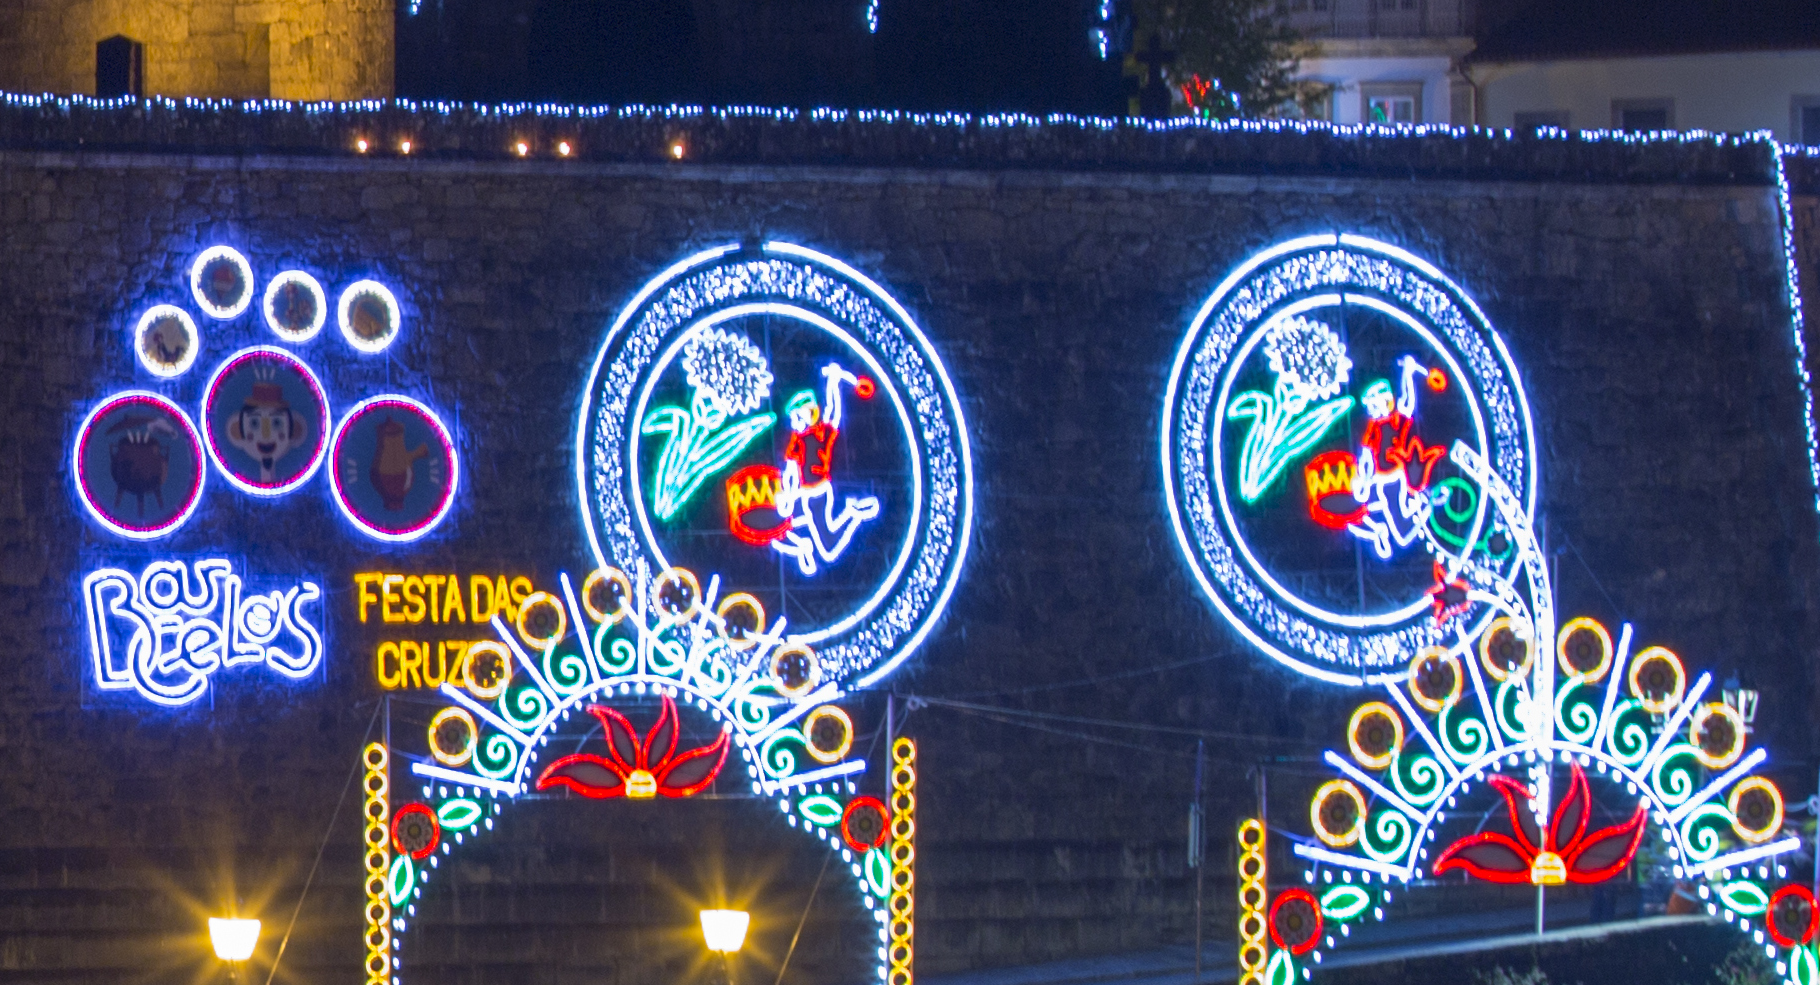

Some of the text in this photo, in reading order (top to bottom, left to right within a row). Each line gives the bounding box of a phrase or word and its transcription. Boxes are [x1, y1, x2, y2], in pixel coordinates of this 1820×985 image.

[354, 571, 533, 623] FESTA DAS
[377, 640, 511, 689] CRUZ
